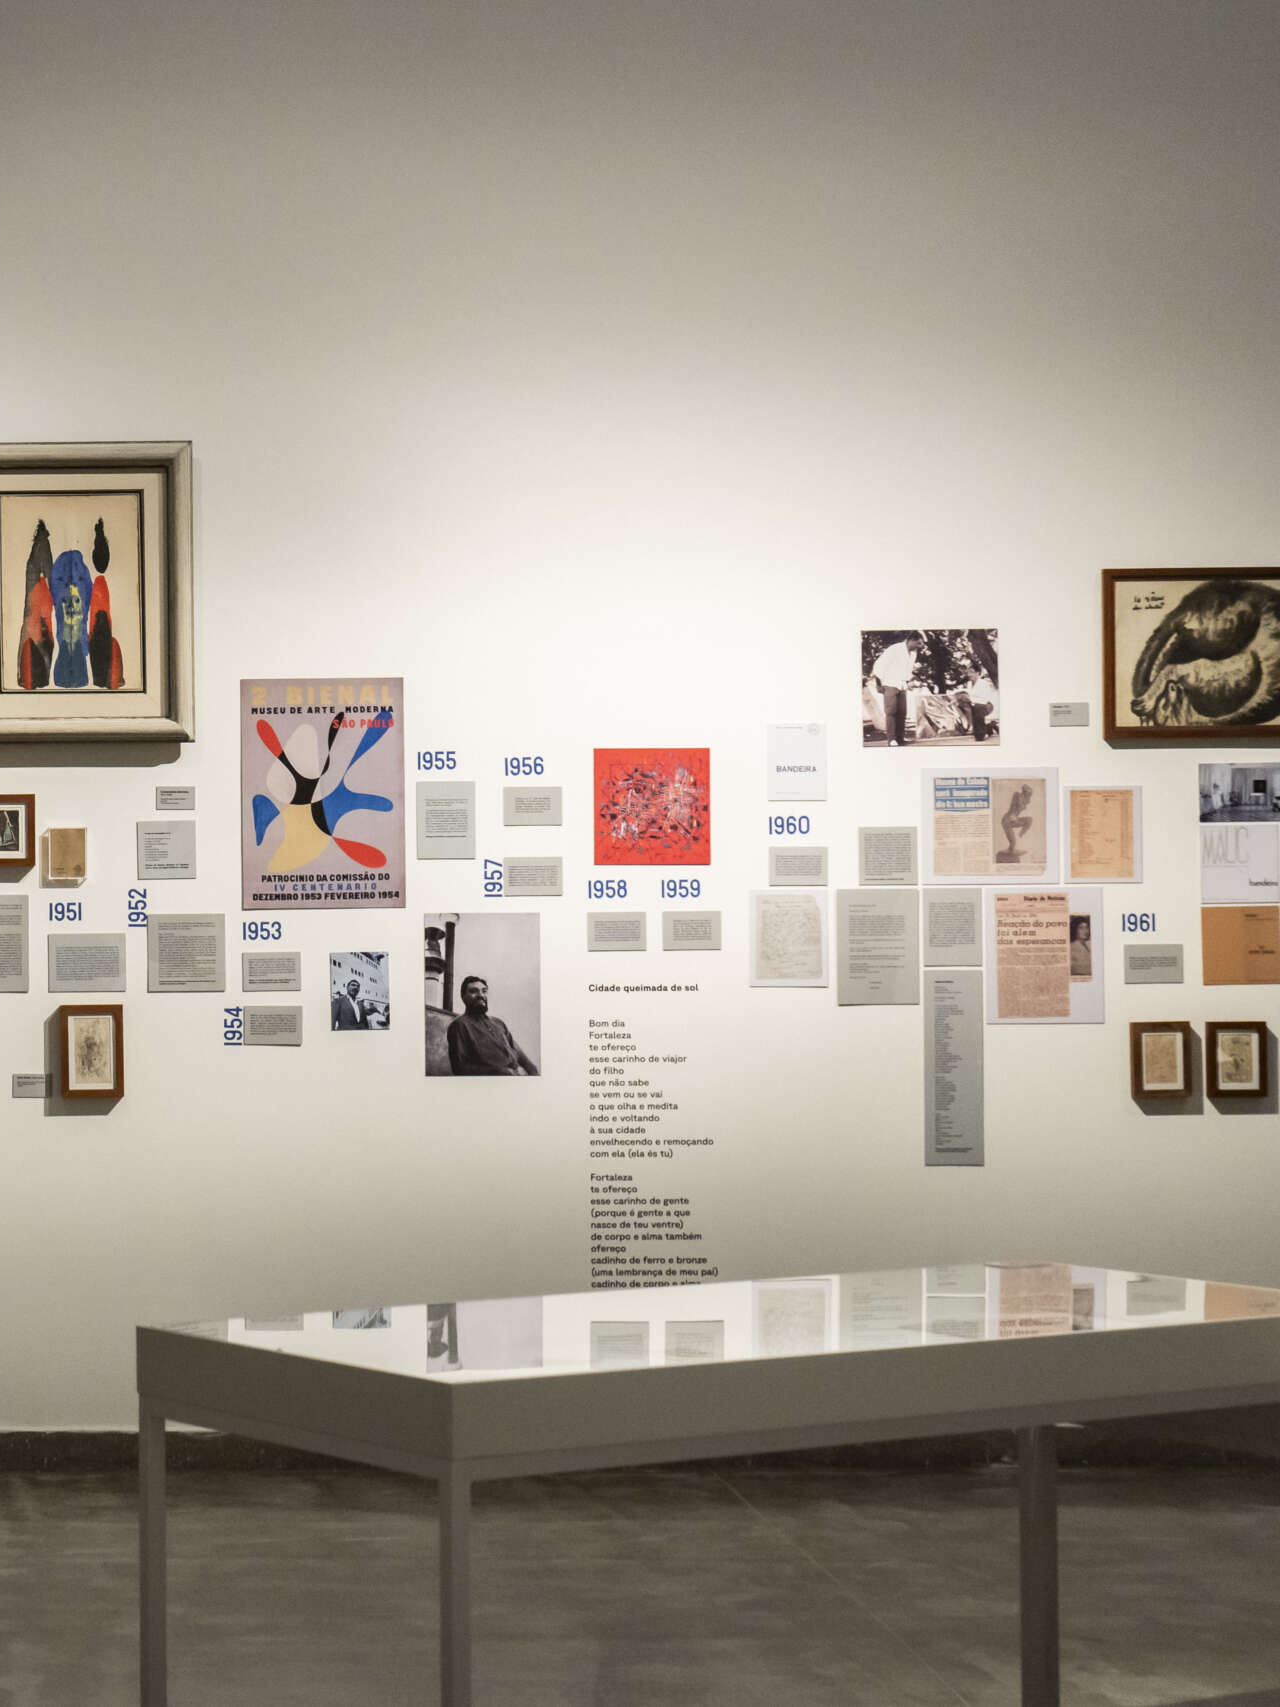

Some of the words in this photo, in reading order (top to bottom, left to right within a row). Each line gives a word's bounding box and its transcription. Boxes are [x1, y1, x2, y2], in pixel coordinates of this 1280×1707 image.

[286, 685, 394, 705] BIENAL
[251, 707, 286, 715] MUSEU
[289, 706, 303, 714] DE
[306, 706, 336, 714] ARTE
[344, 705, 394, 713] MODERNA
[360, 719, 395, 729] PAULO
[417, 751, 456, 770] 1955
[504, 757, 544, 776] 1956
[776, 765, 817, 773] BANDEIRA
[768, 816, 809, 835] 1960
[261, 874, 314, 883] PATROCINIO
[316, 874, 328, 882] DA
[329, 871, 376, 882] COMISSÃO
[484, 859, 502, 897] 1957
[274, 884, 286, 892] IV
[293, 883, 377, 891] CENTENARIO
[588, 880, 627, 899] 1958
[661, 879, 700, 898] 1959
[252, 893, 299, 901] DEZEMBRO
[324, 892, 376, 900] FEVEREIRO
[378, 891, 400, 899] 1954
[49, 903, 81, 921] 1951
[128, 888, 148, 928] 1952
[1121, 913, 1155, 932] 1961
[242, 922, 282, 940] 1953
[588, 984, 621, 992] Cidade
[623, 984, 668, 993] queimada
[670, 984, 682, 992] de
[684, 984, 699, 992] sol
[224, 1006, 242, 1045] 1954
[589, 1019, 609, 1028] Bom
[611, 1019, 625, 1028] dia
[589, 1031, 632, 1039] Fortaleza
[601, 1043, 636, 1053] ofereço
[612, 1055, 646, 1063] carinho
[662, 1056, 687, 1064] viajor
[589, 1067, 601, 1075] do
[603, 1066, 624, 1075] filho
[608, 1078, 626, 1087] não
[628, 1079, 649, 1087] sabe
[598, 1104, 615, 1112] que
[617, 1102, 637, 1110] olha
[589, 1114, 609, 1122] indo
[620, 1114, 660, 1122] voltando
[615, 1126, 646, 1134] cidade
[590, 1138, 653, 1146] envelhecendo
[663, 1137, 714, 1147] remoçando
[611, 1150, 625, 1158] ela
[628, 1149, 645, 1159] (ela
[647, 1150, 658, 1158] és
[660, 1148, 673, 1159] tu)
[590, 1173, 633, 1181] Fortaleza
[602, 1185, 638, 1195] ofereço
[613, 1197, 647, 1205] carinho
[649, 1197, 661, 1205] de
[663, 1197, 689, 1207] gente
[591, 1208, 627, 1218] (porque
[637, 1209, 663, 1218] gente
[651, 1219, 684, 1230] ventre)
[604, 1234, 631, 1242] corpo
[665, 1232, 702, 1240] também
[591, 1244, 626, 1254] ofereço
[590, 1256, 627, 1265] cadinho
[629, 1256, 641, 1264] de
[643, 1256, 666, 1264] ferro
[676, 1256, 708, 1264] bronze
[591, 1267, 613, 1278] (uma
[616, 1268, 663, 1277] lembrança
[665, 1268, 677, 1276] de
[701, 1267, 718, 1277] pai)
[591, 1280, 627, 1288] cadinho
[629, 1280, 641, 1288] de
